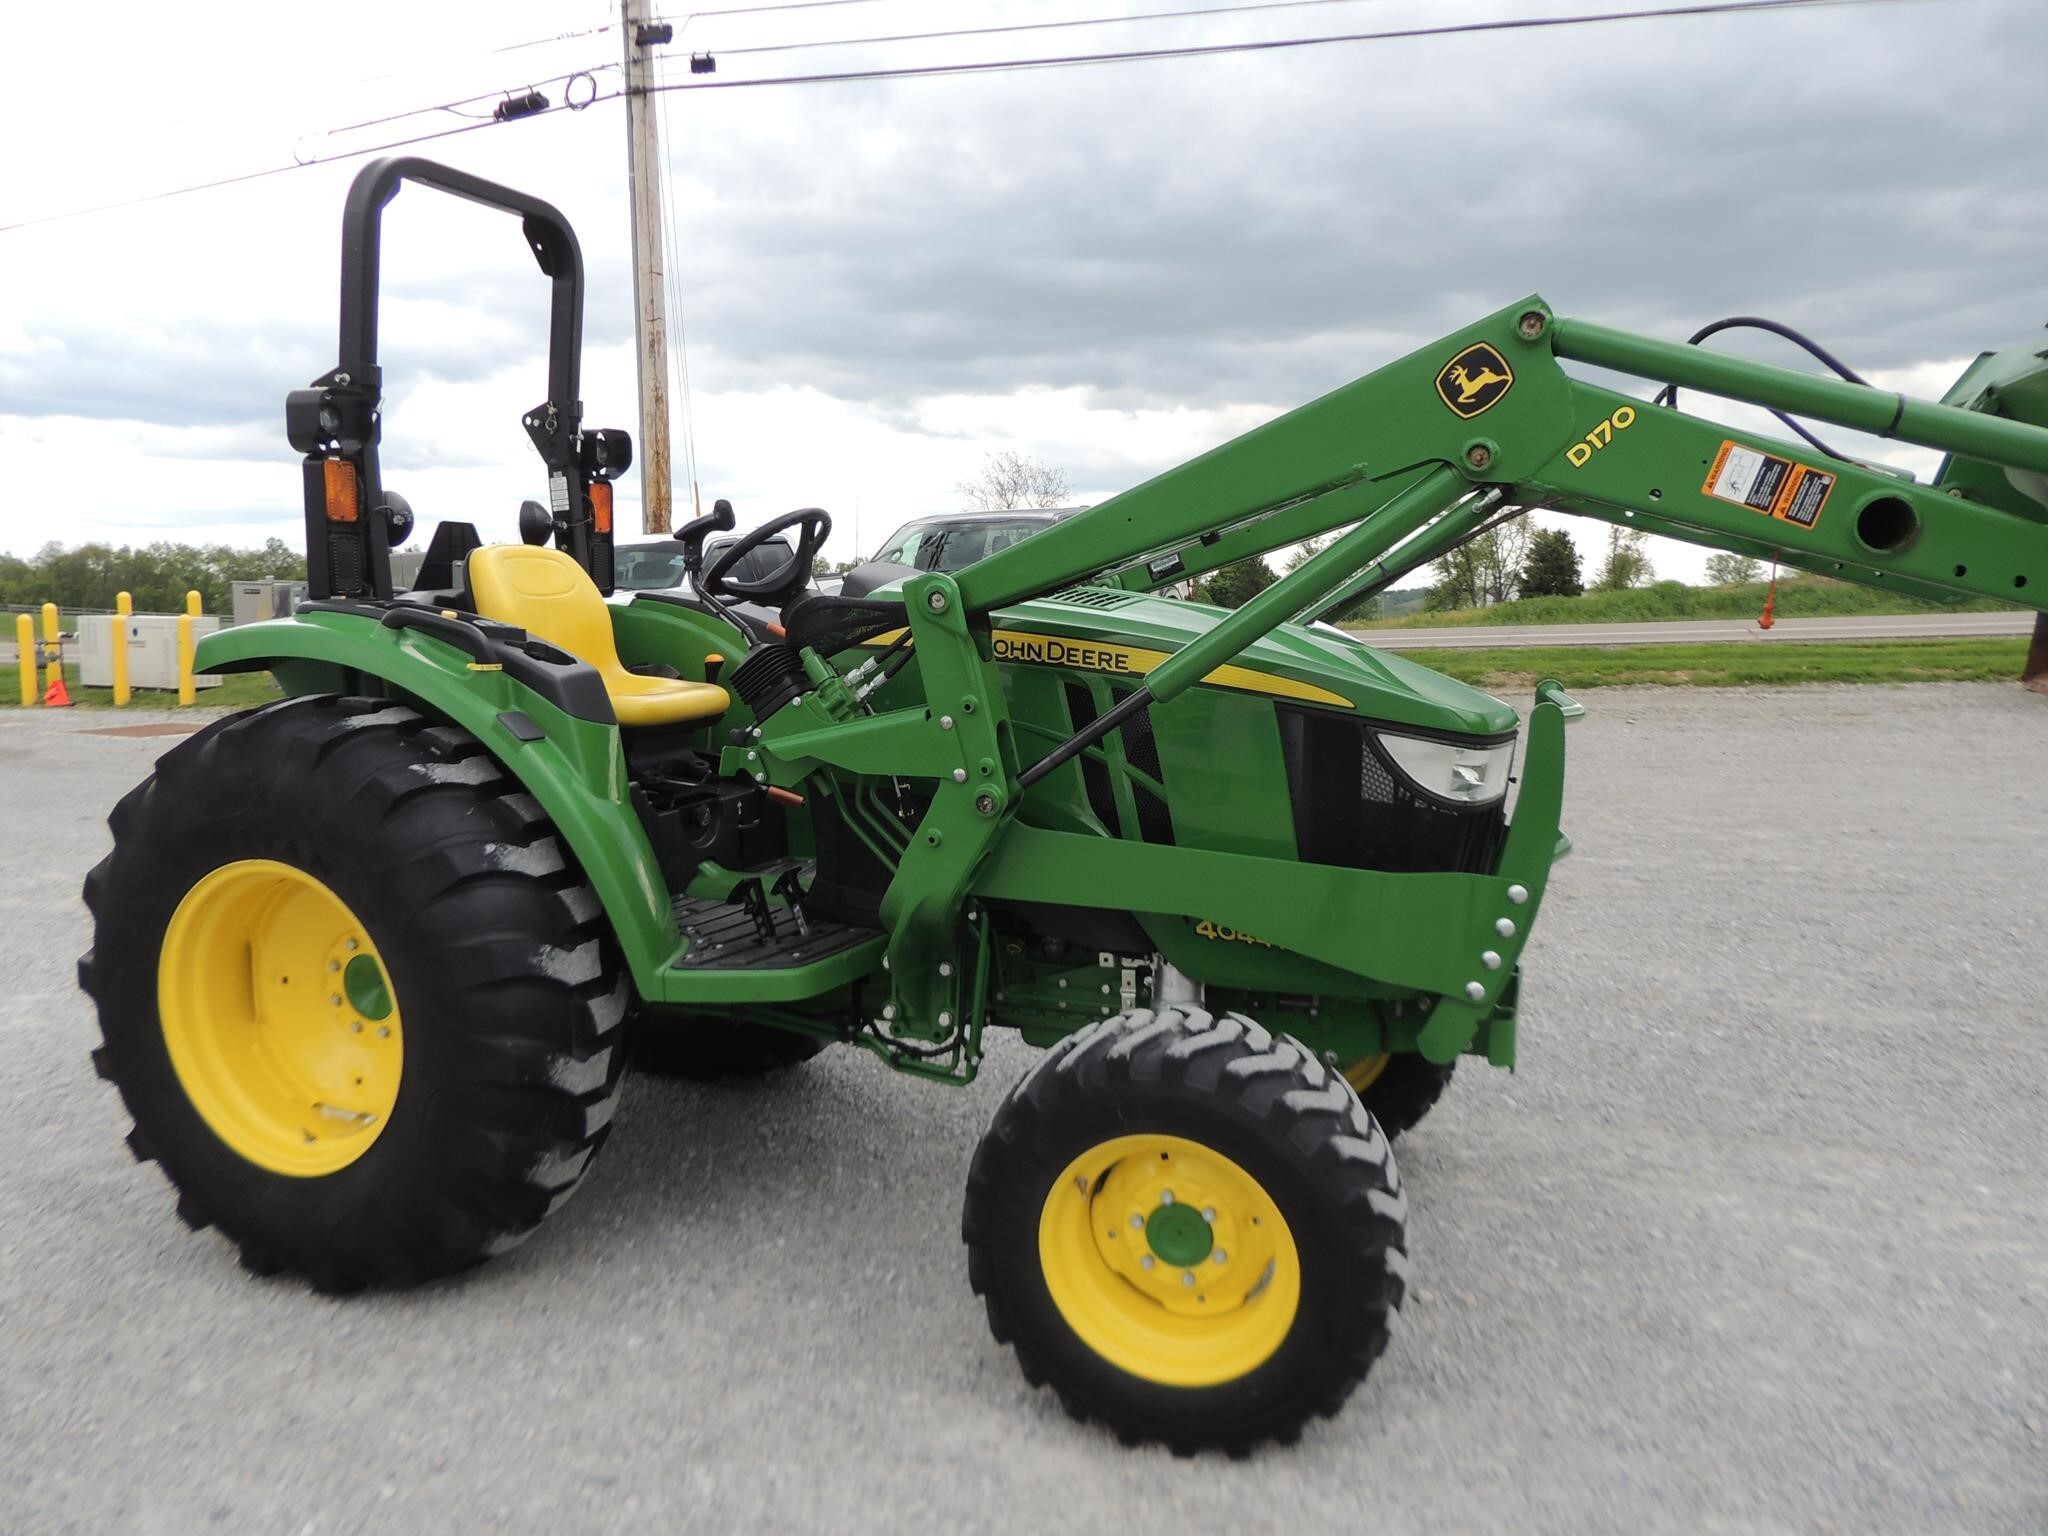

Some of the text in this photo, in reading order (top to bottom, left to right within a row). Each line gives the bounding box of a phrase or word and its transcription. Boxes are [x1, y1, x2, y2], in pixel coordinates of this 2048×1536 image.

[1565, 405, 1636, 468] D170
[1710, 447, 1729, 480] WARNING
[1783, 470, 1803, 503] WARNING
[993, 639, 1129, 670] OHN DEERE
